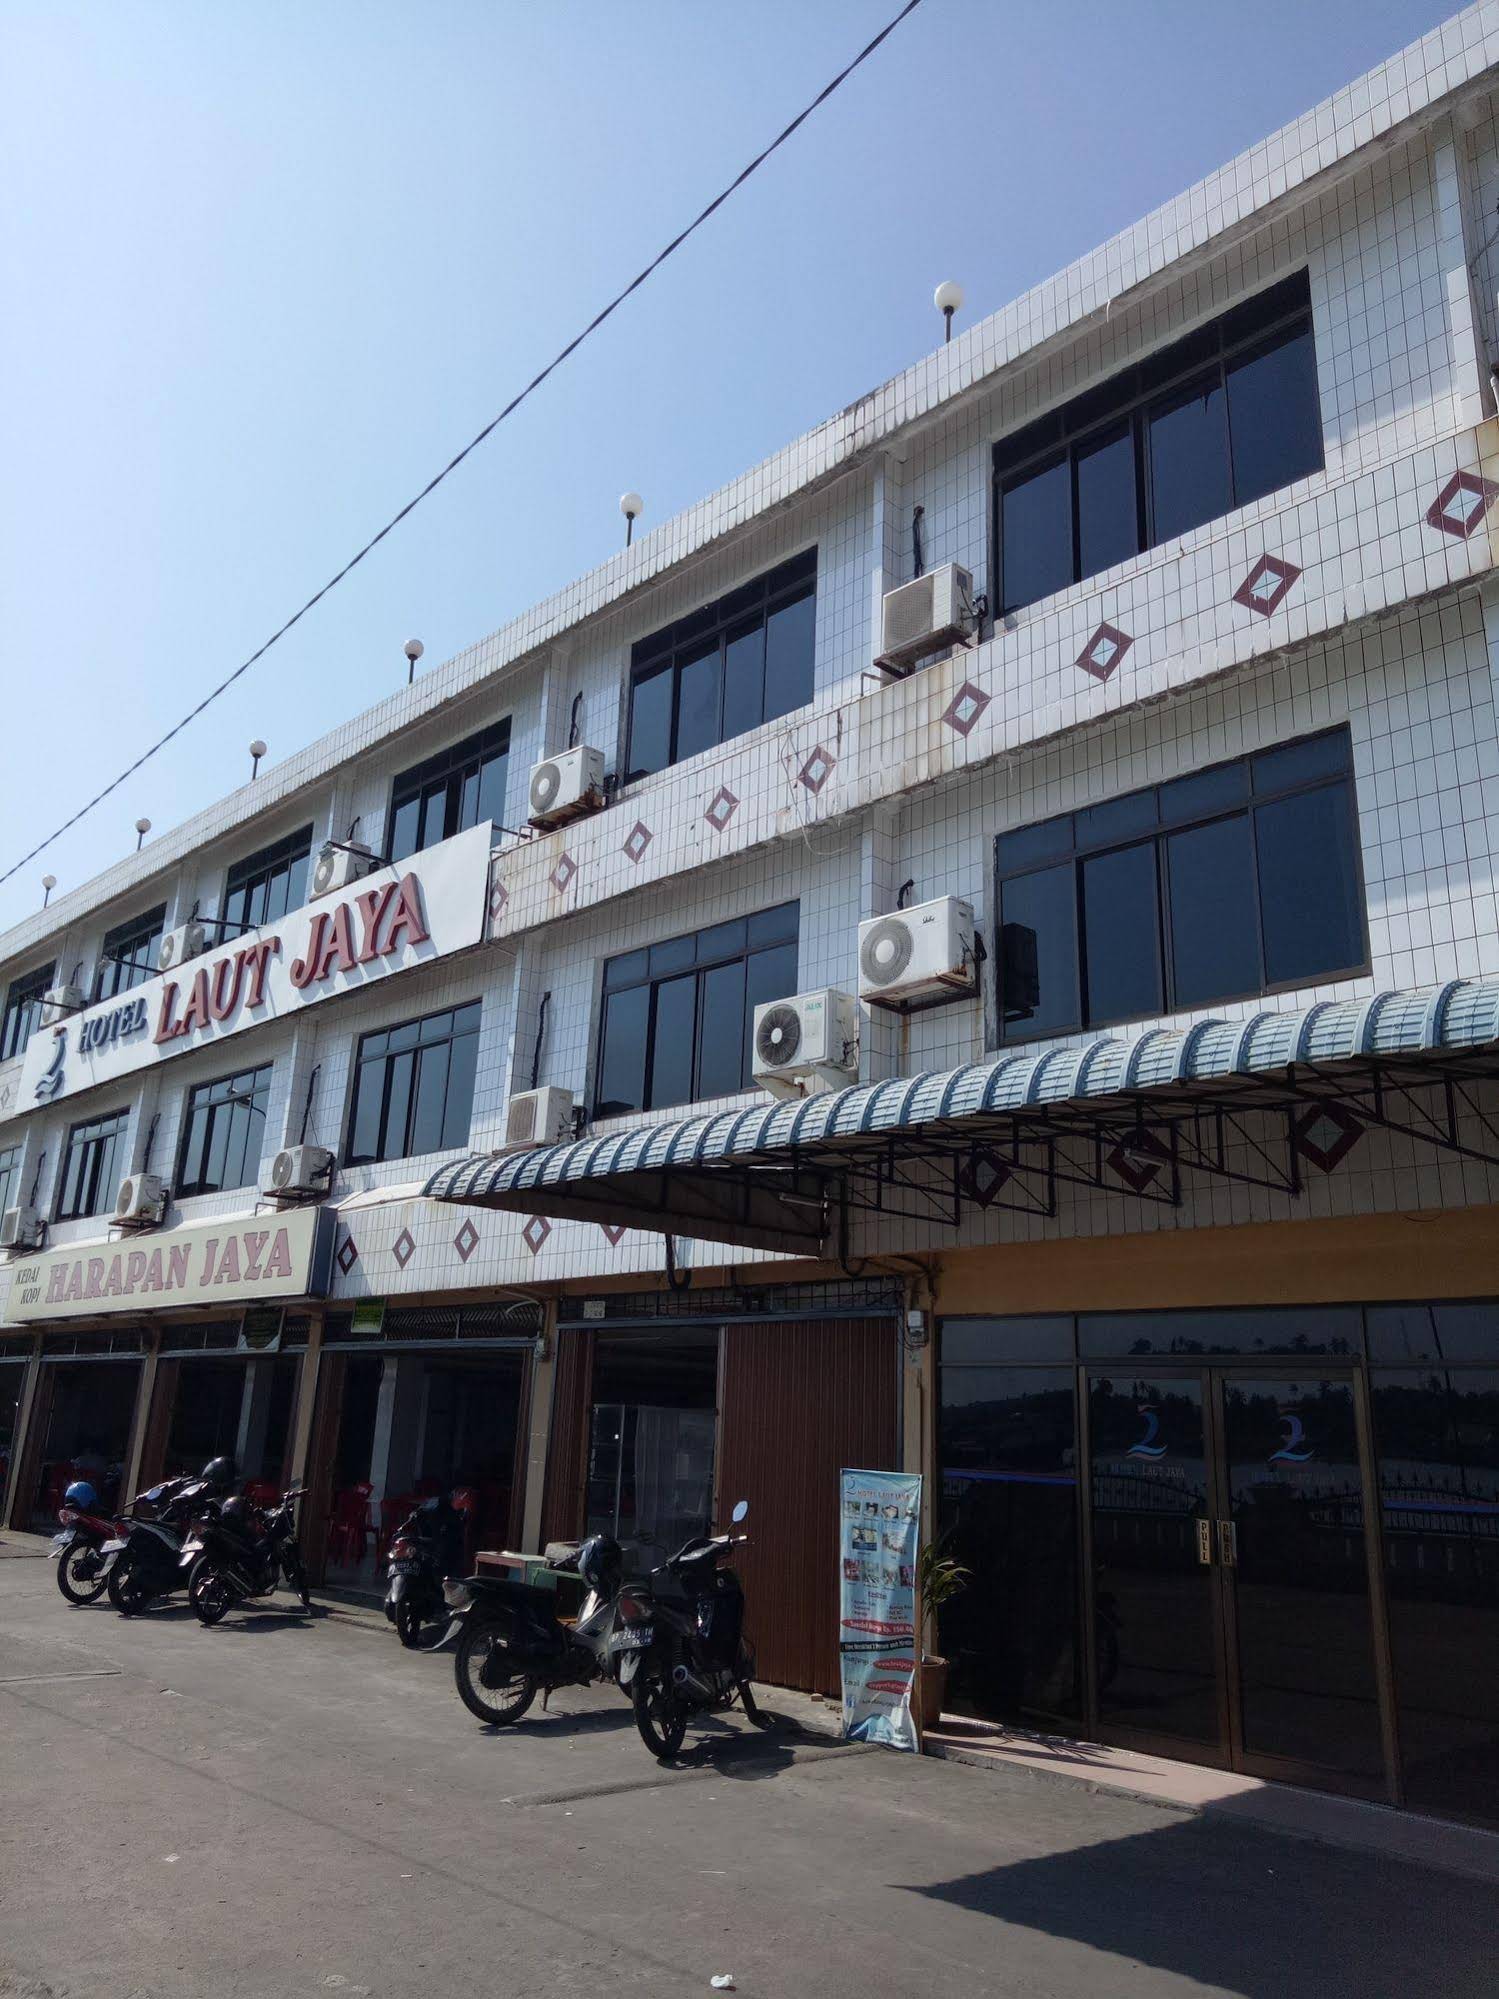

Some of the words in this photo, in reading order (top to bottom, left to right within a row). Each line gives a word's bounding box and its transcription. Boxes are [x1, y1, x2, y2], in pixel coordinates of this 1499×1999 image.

[78, 997, 148, 1053] HOTEL
[152, 936, 280, 1044] LAUT
[290, 872, 430, 987] JAYA
[15, 1267, 40, 1285] KEDAI
[45, 1243, 192, 1305] HARAPAN
[199, 1228, 293, 1287] JAYA
[20, 1287, 41, 1305] KOPI
